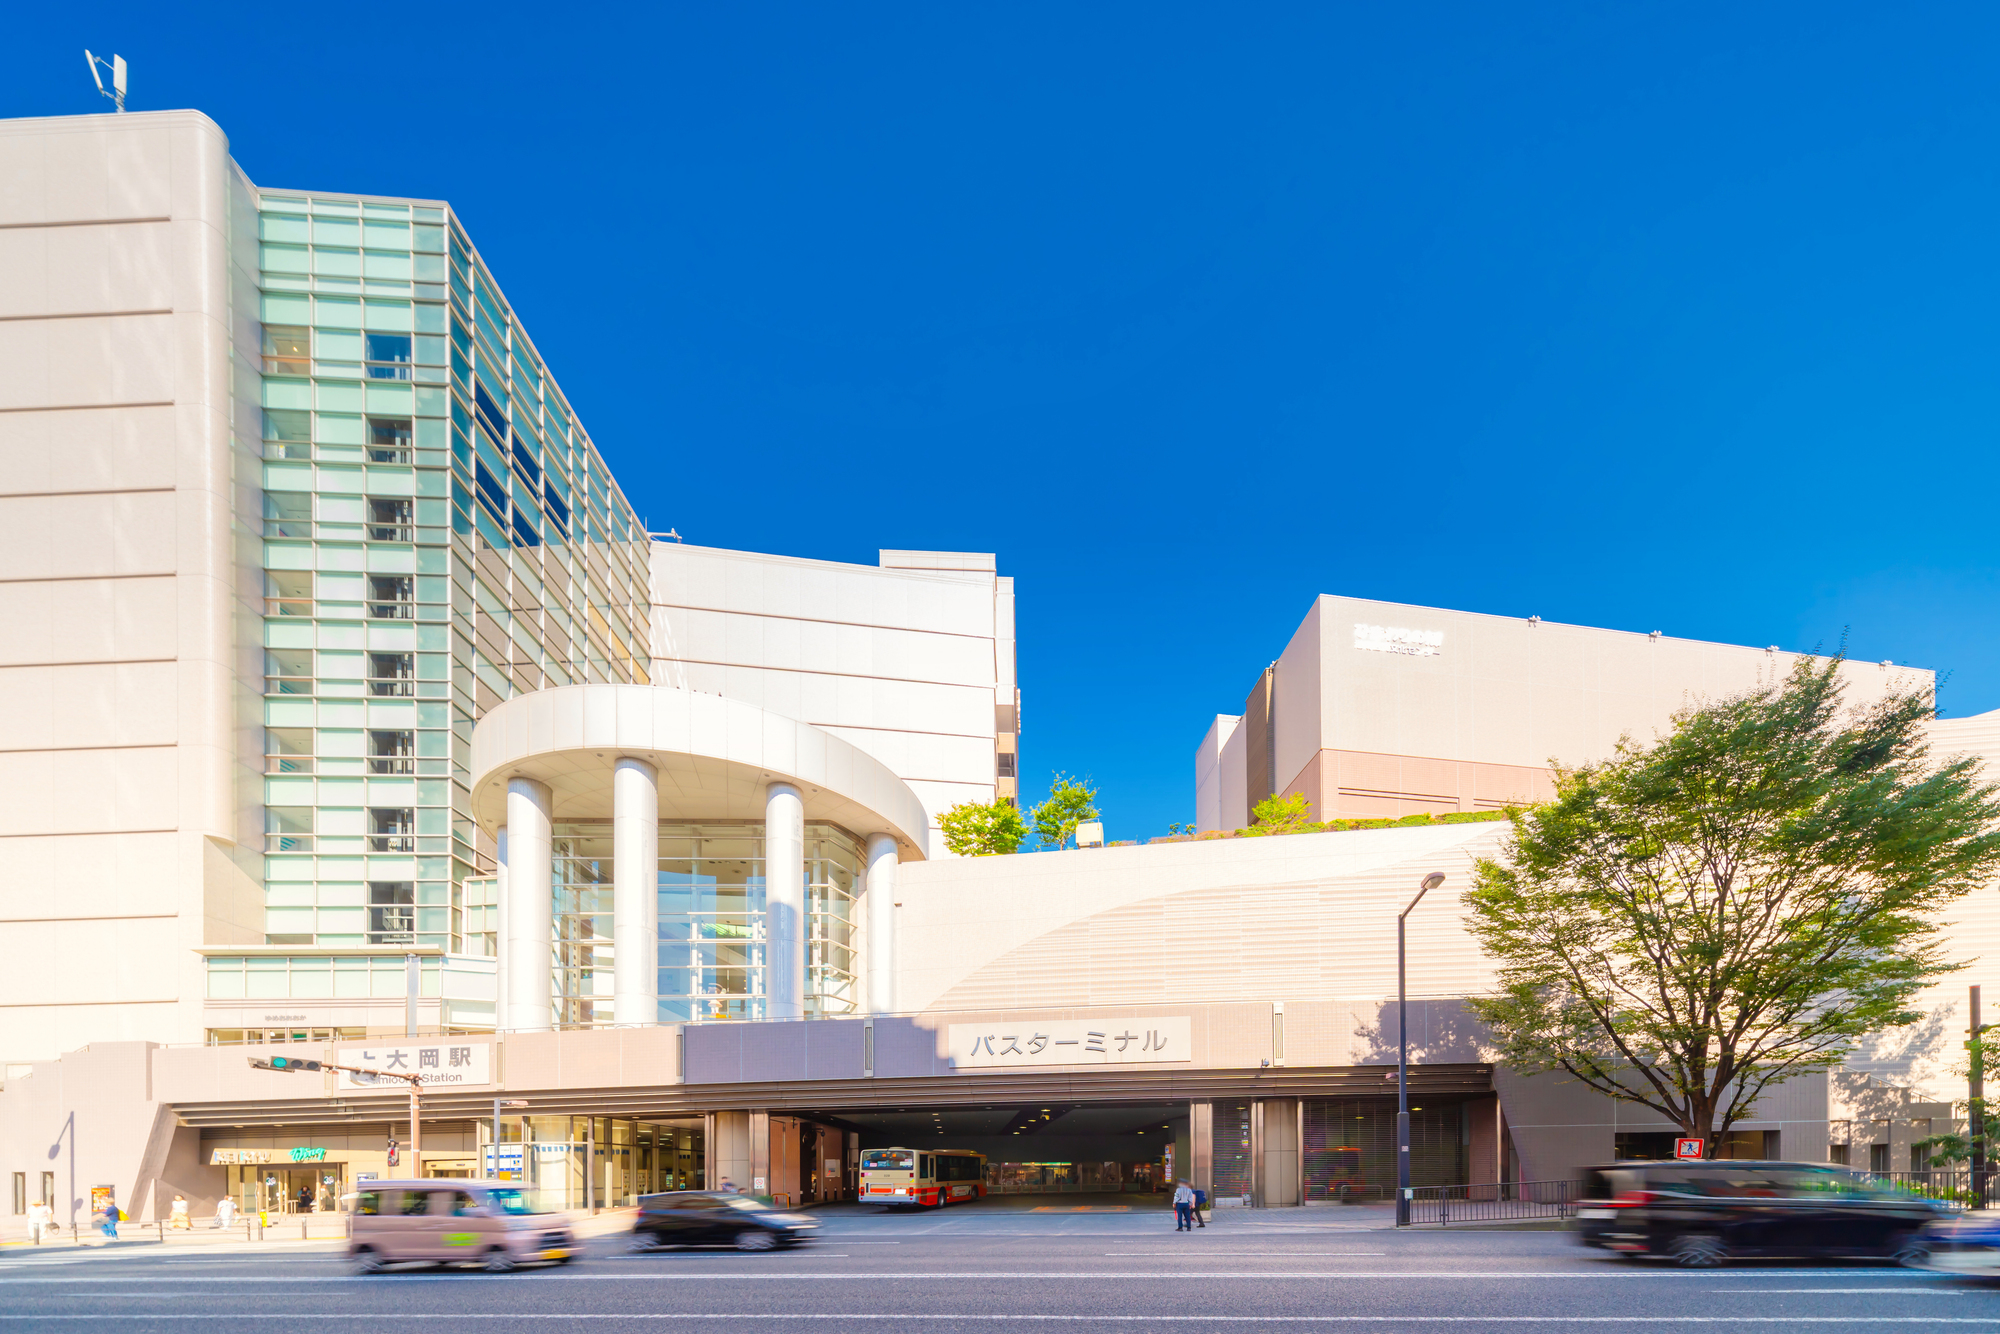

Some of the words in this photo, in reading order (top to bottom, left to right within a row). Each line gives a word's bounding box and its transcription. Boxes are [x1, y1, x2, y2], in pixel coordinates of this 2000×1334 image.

[970, 1029, 1168, 1057] バスターミナル
[421, 1073, 463, 1083] Station
[214, 1151, 271, 1162] KEIKYU
